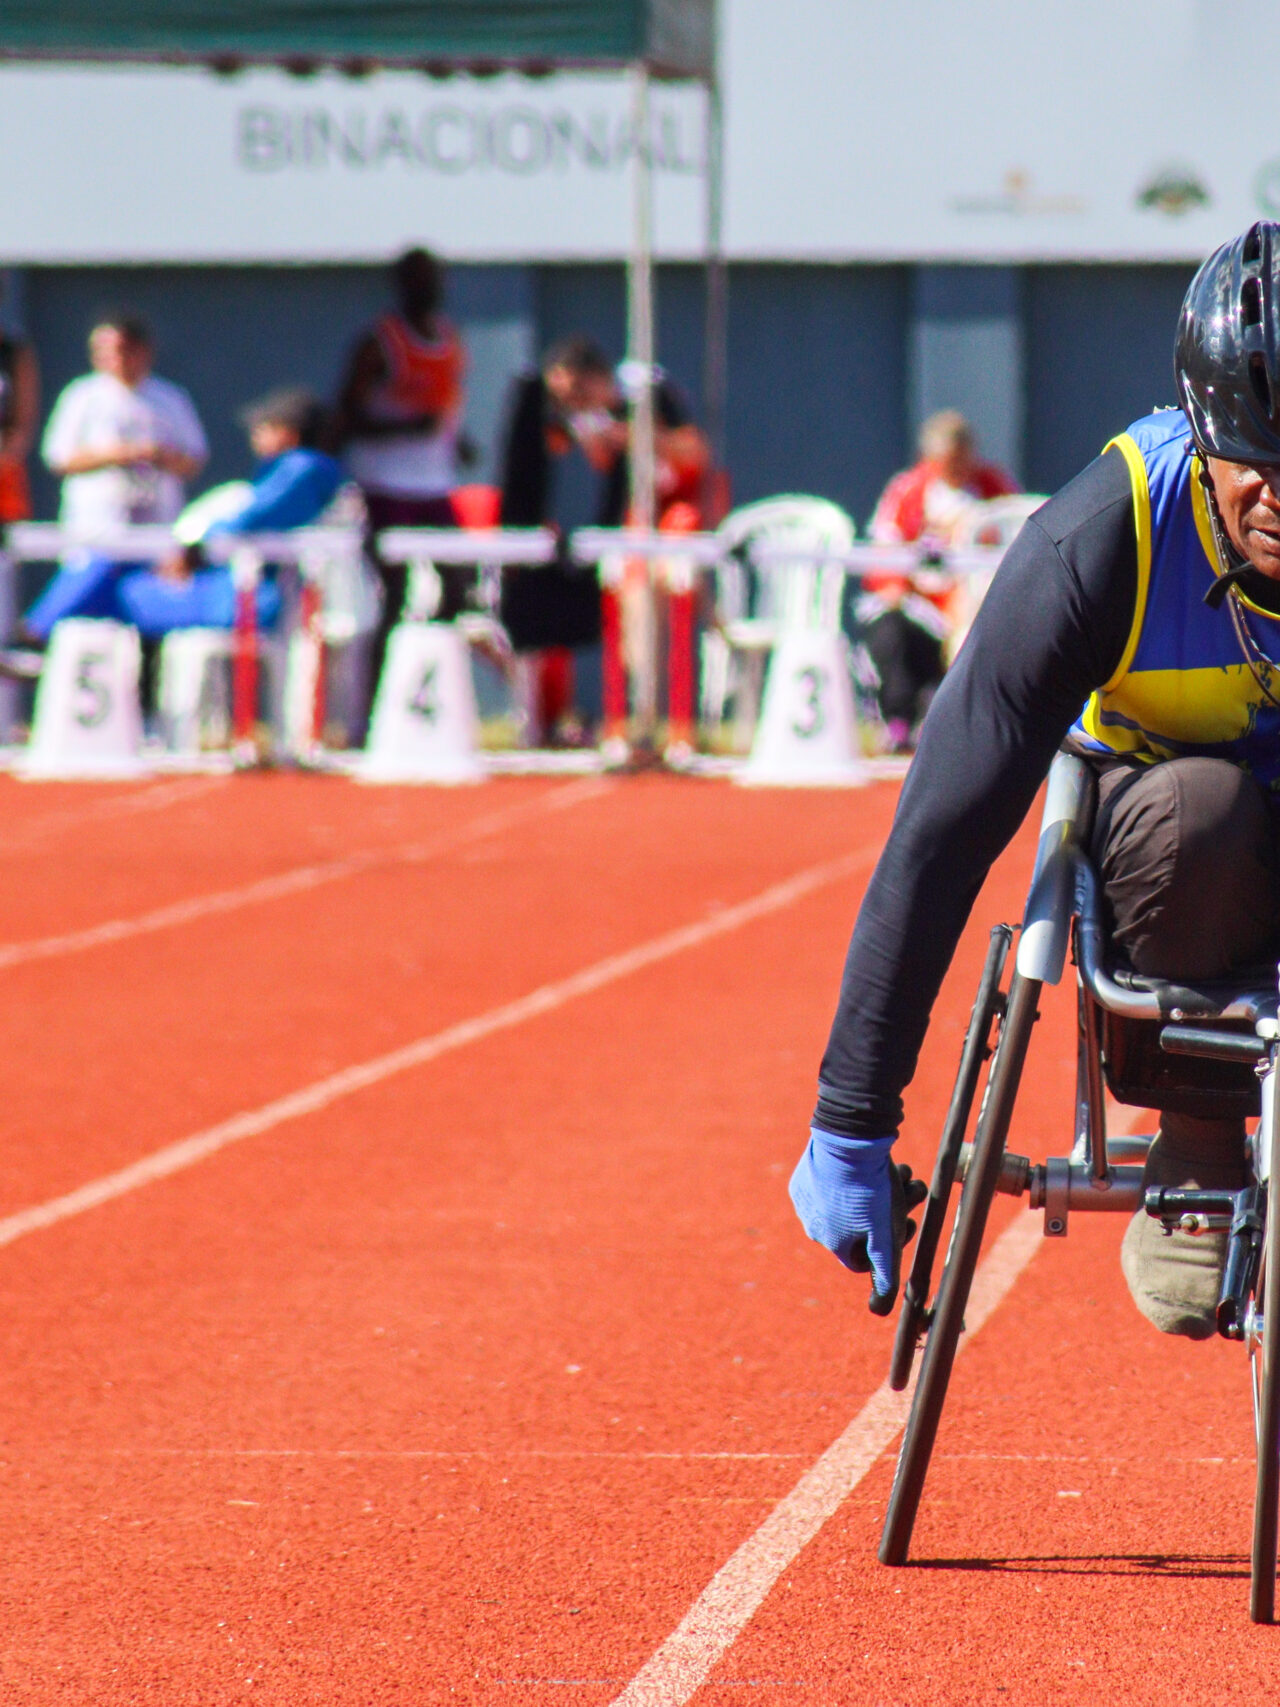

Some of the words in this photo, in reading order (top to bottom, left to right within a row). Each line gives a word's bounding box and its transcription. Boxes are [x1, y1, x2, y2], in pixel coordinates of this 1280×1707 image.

[238, 104, 705, 174] BINACIONAL
[75, 652, 110, 727] 5
[406, 659, 442, 726] 4
[791, 665, 827, 739] 3
